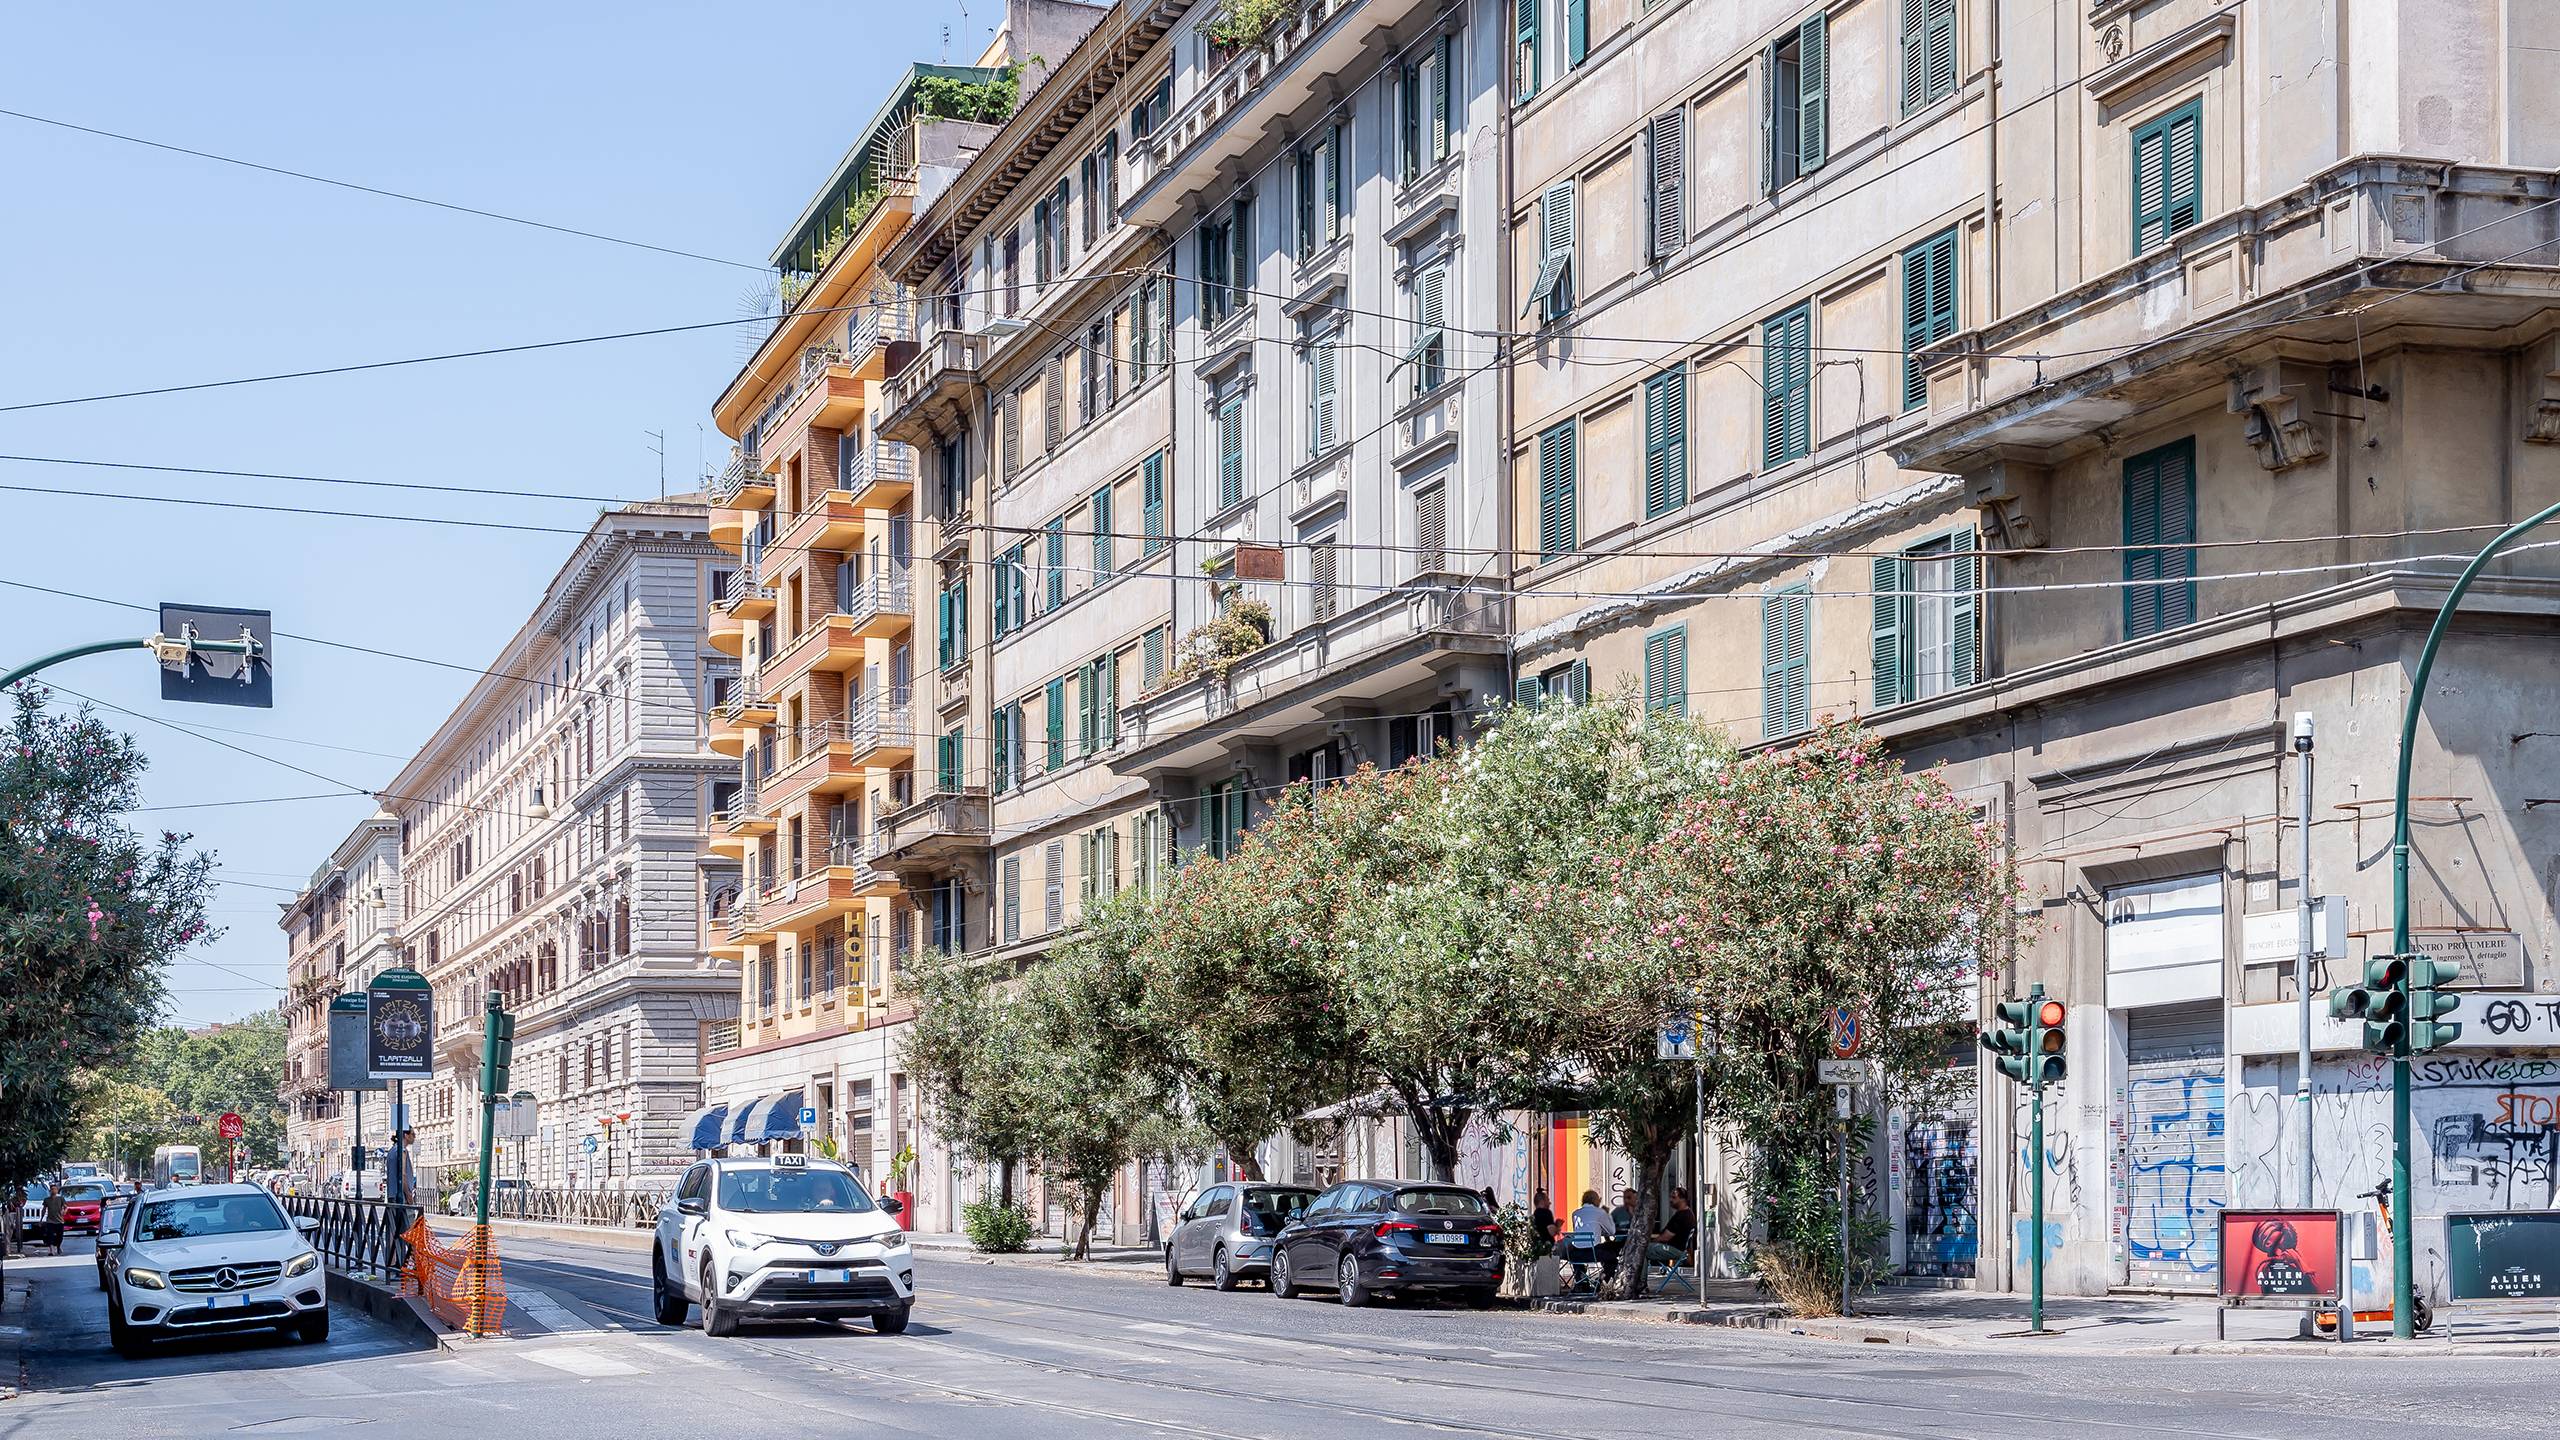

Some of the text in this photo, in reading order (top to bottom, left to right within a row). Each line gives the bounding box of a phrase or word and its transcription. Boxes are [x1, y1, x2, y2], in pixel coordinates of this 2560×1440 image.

[2411, 940, 2507, 953] ENTRO PROFUMERIE
[2477, 952, 2507, 961] dettaglio
[844, 912, 864, 1032] HOTEL
[803, 1110, 812, 1121] P
[779, 1156, 802, 1166] TAXI
[2257, 1271, 2302, 1279] ALIEN
[2490, 1275, 2541, 1283] ALIEN
